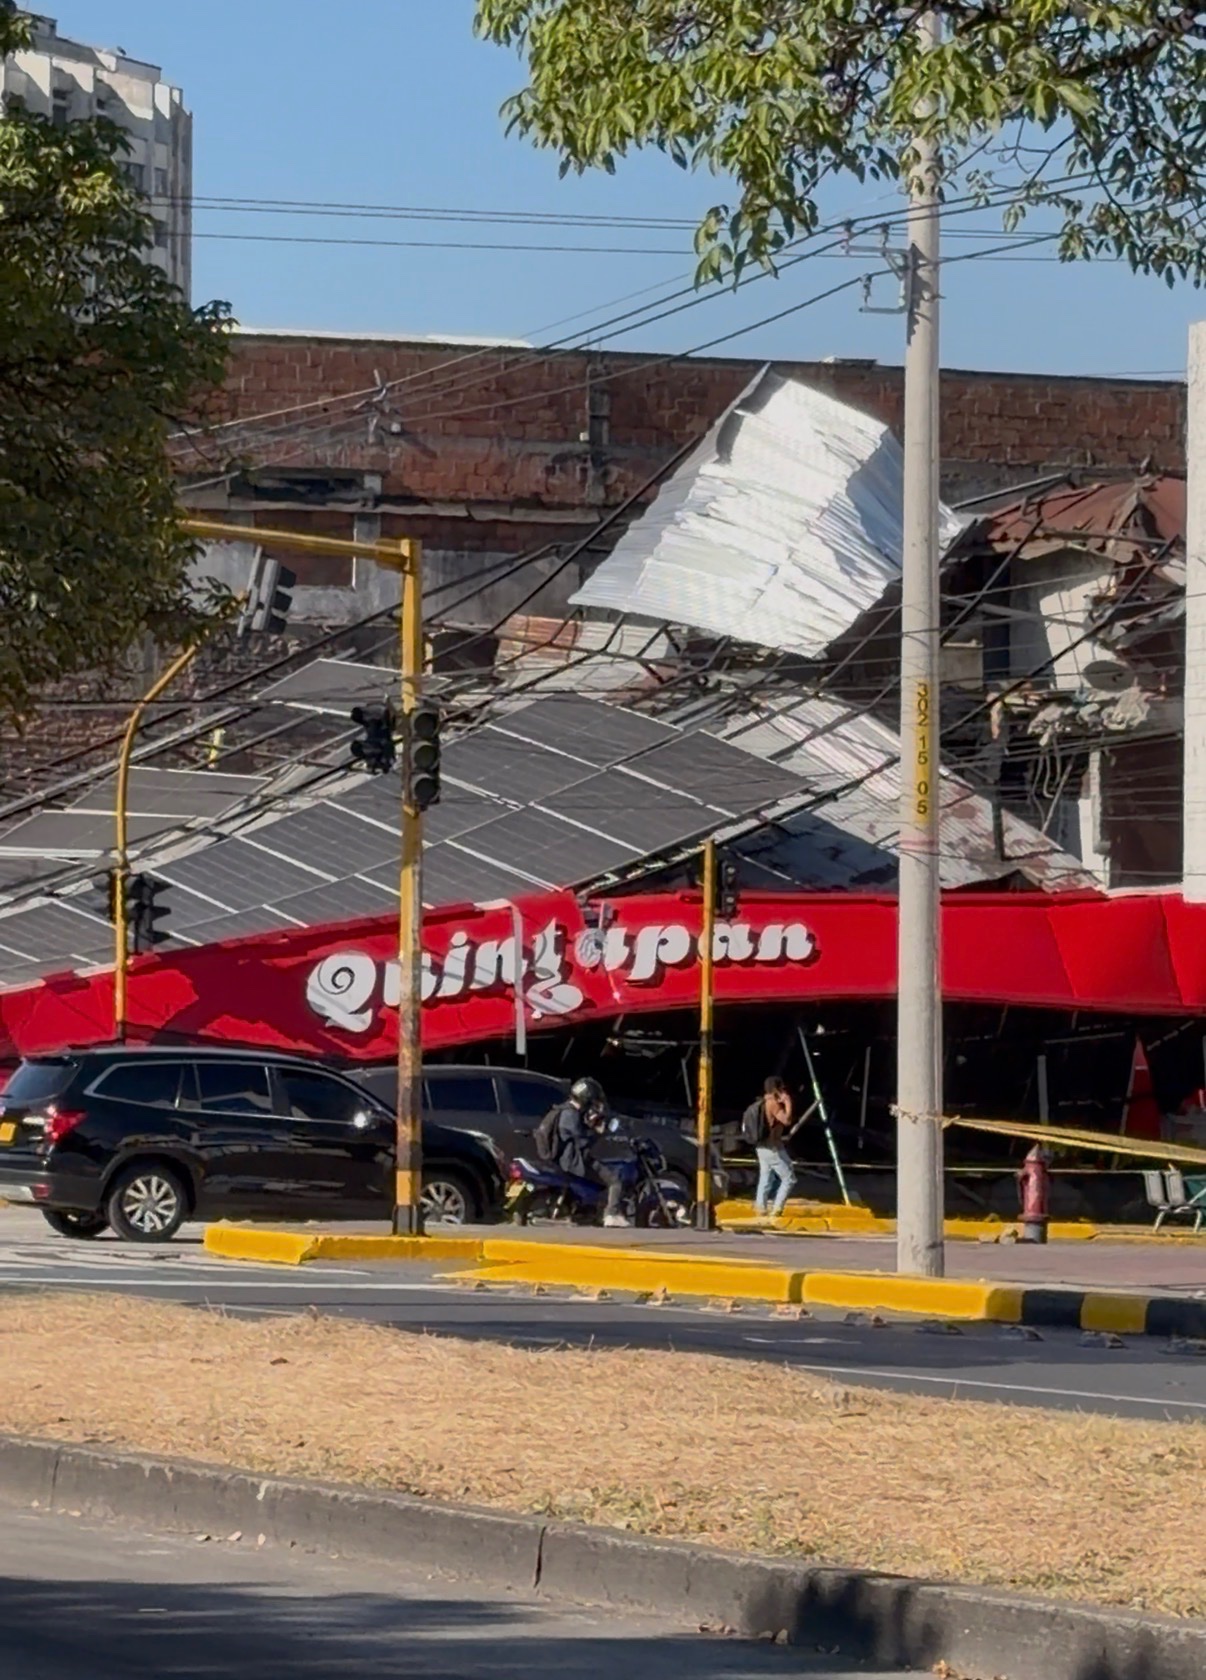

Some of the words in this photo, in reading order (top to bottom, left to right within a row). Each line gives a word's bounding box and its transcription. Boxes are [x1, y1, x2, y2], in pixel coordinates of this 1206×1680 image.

[917, 683, 929, 727] 302
[917, 736, 928, 766] 15
[916, 781, 929, 815] 05
